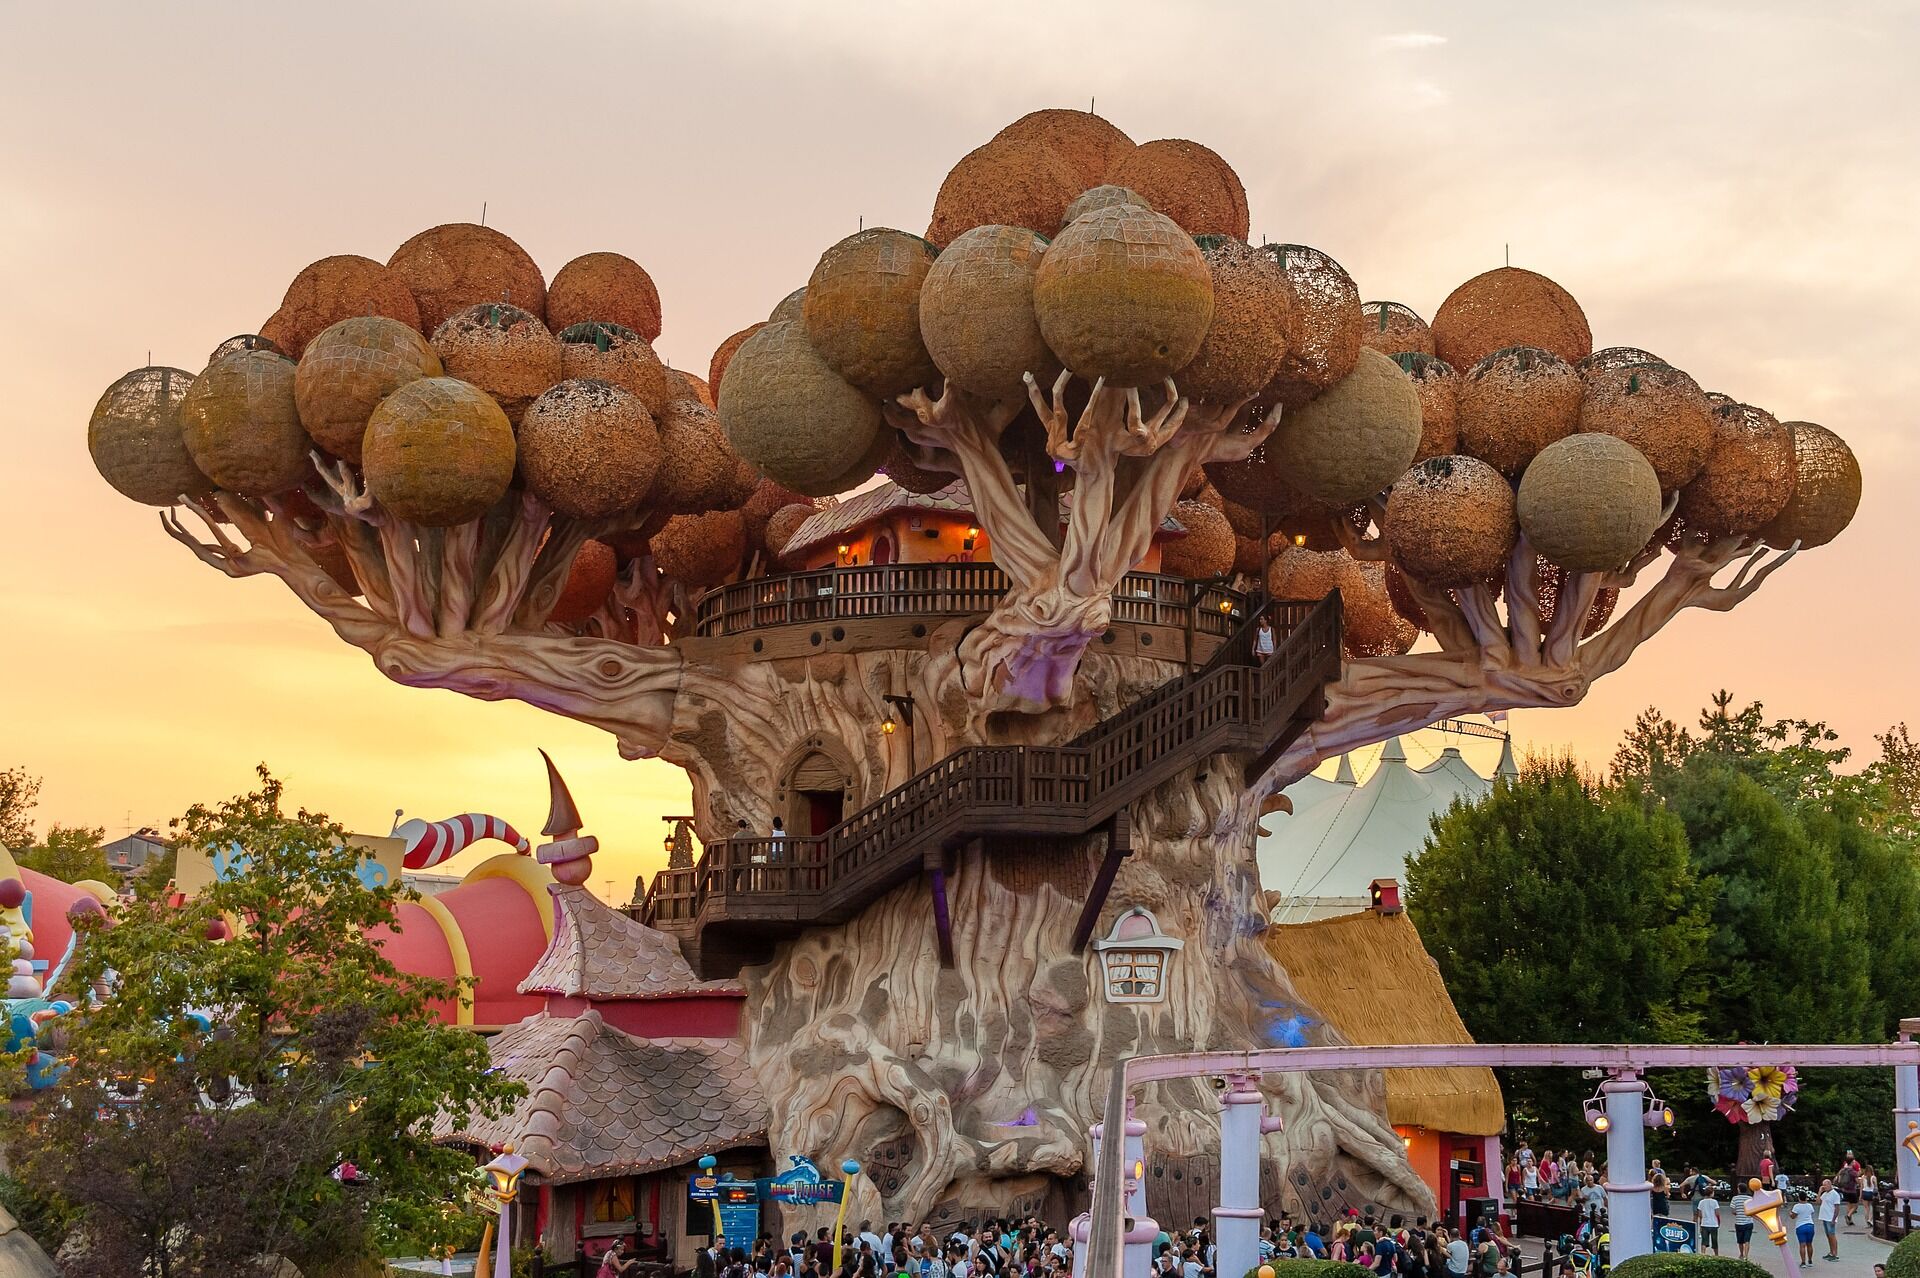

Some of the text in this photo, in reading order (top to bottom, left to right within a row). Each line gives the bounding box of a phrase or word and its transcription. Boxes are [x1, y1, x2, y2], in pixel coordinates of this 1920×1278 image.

[795, 1181, 834, 1199] HOUSE
[1665, 1228, 1684, 1239] SEA LIFE
